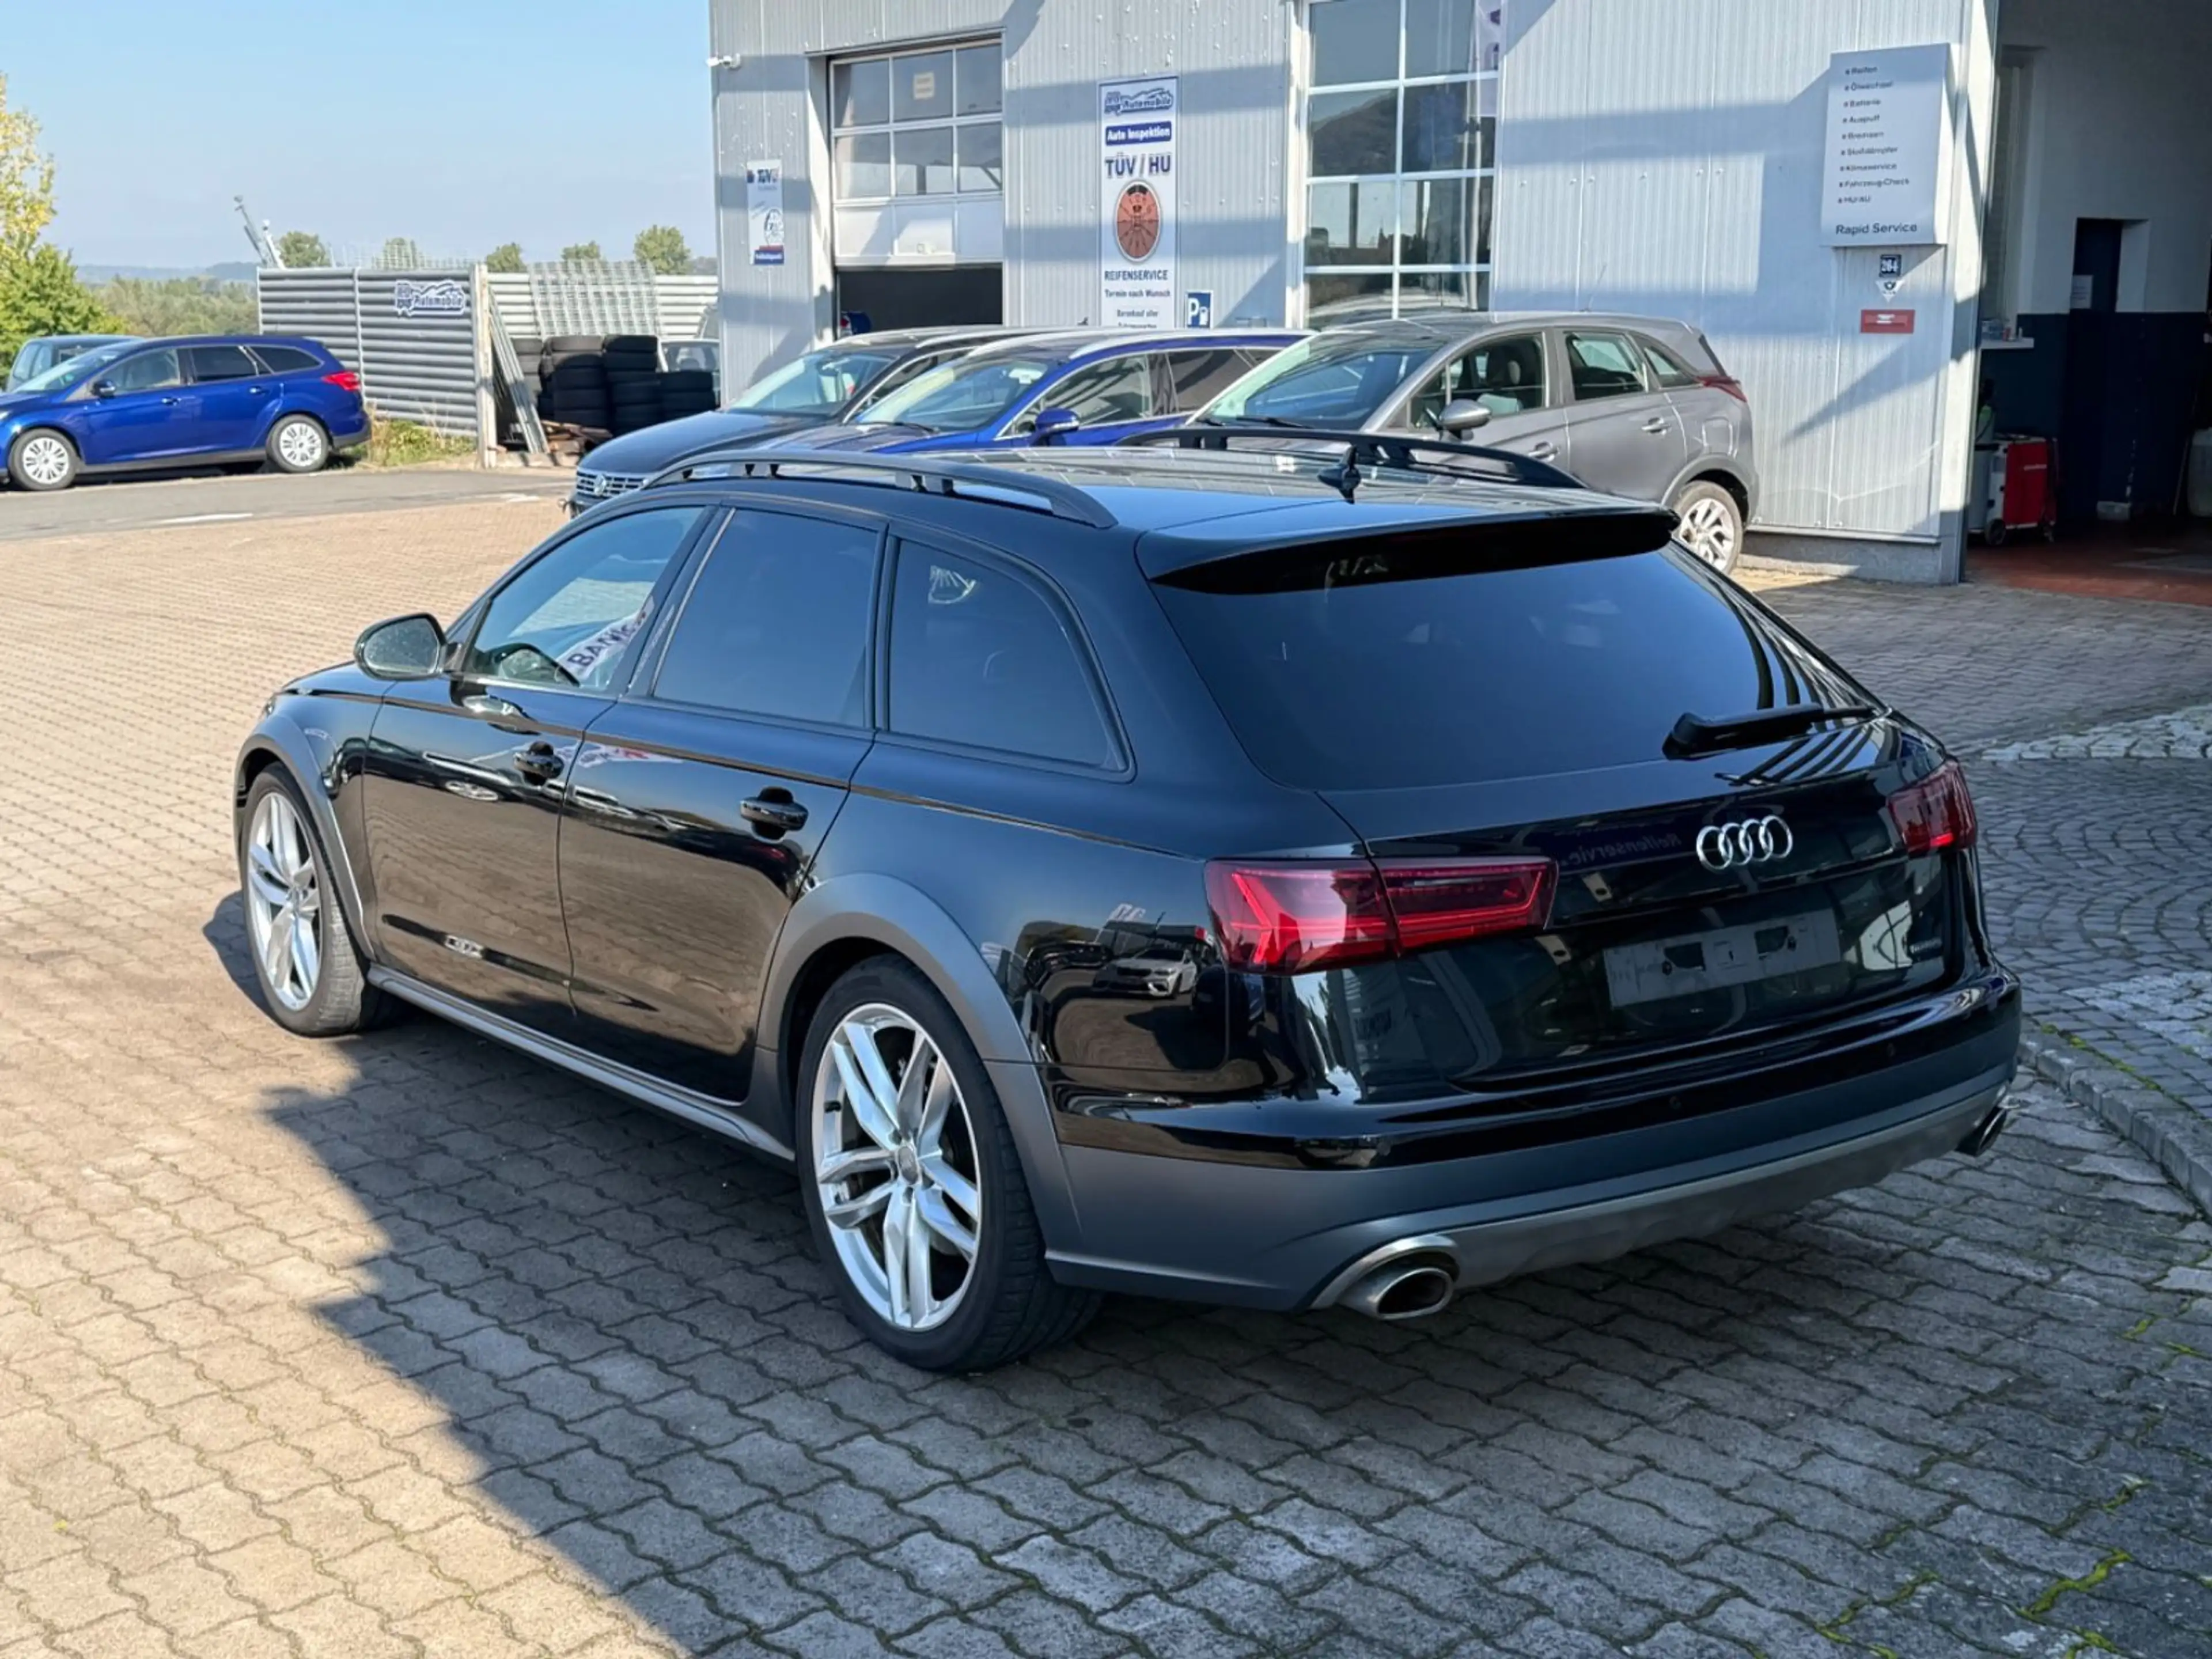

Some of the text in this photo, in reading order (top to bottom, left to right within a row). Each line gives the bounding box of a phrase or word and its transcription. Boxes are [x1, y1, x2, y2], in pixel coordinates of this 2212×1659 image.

[1107, 125, 1171, 141] Auto Inspektion
[1105, 152, 1137, 178] TÜV
[1148, 152, 1172, 176] HU
[1835, 222, 1918, 237] Rapid Service
[1104, 269, 1168, 281] REIFENSERVICE
[1188, 297, 1199, 325] P
